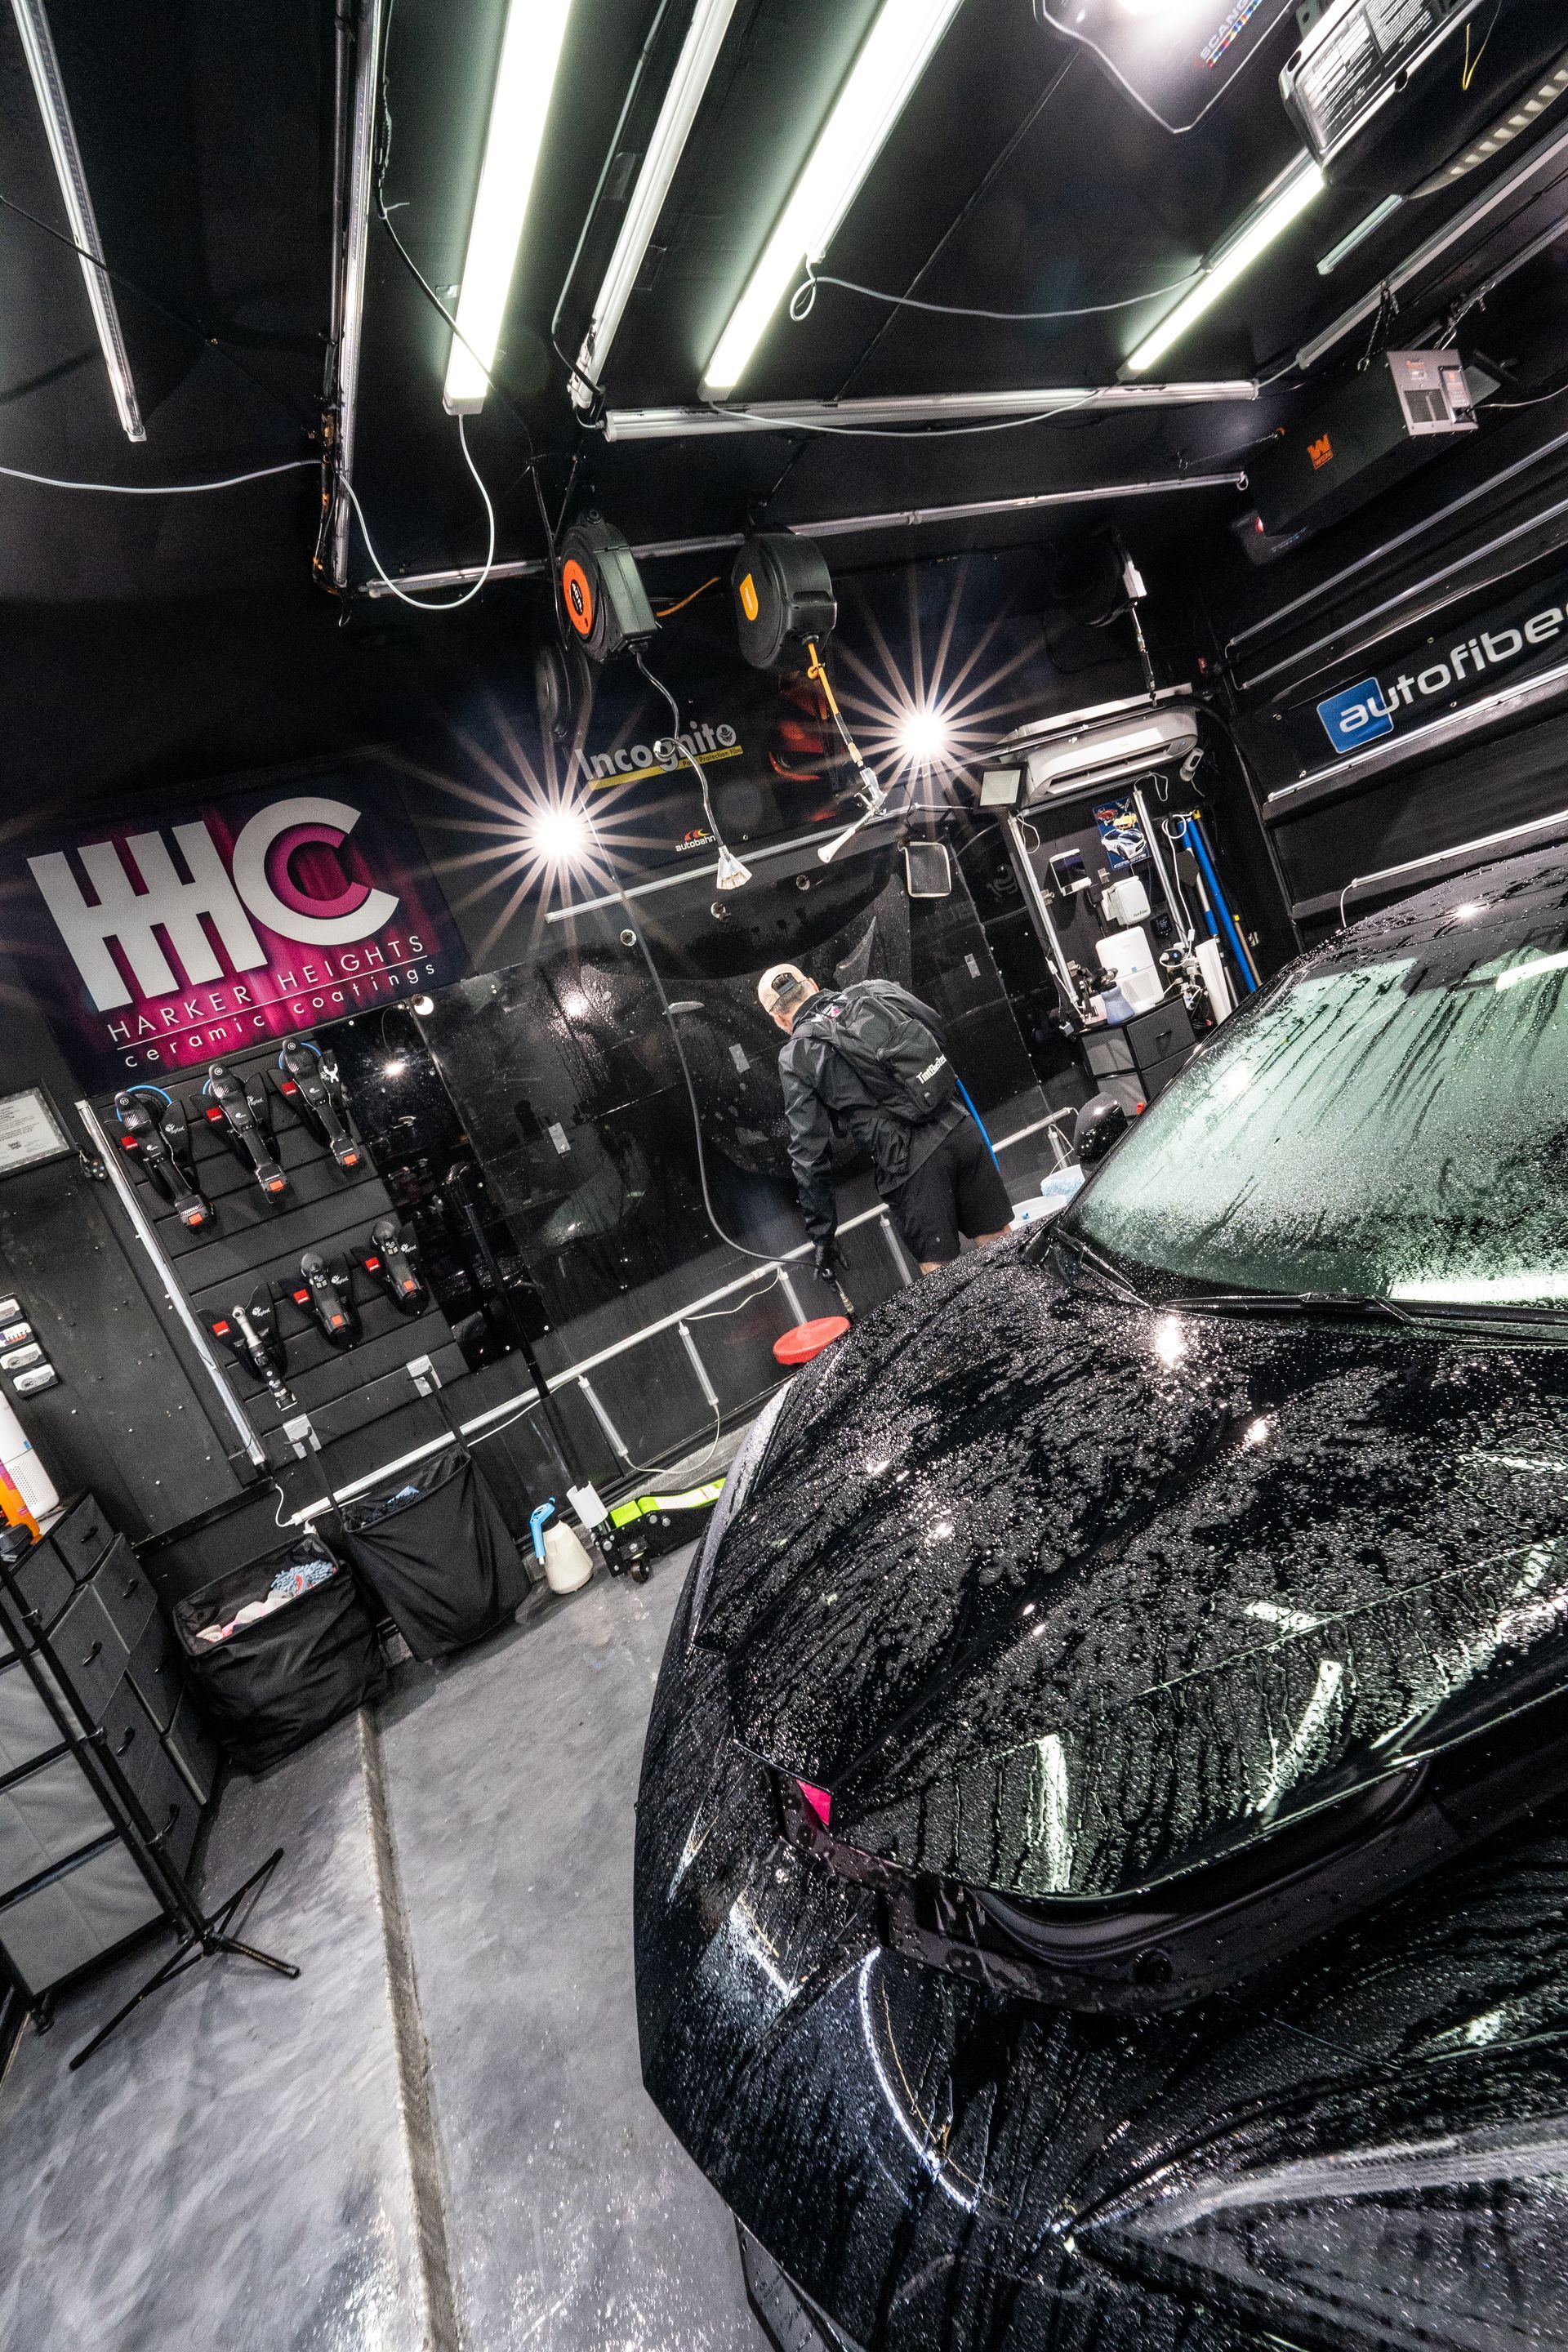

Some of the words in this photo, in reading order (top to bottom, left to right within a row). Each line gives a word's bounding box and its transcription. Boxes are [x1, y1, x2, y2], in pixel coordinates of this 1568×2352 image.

[1339, 603, 1568, 733] autofibe
[699, 751, 729, 763] Protection
[729, 748, 742, 756] Film
[675, 835, 716, 852] autobahn
[107, 986, 252, 1042] HARKER
[277, 936, 424, 991] HEIGHTS
[125, 1014, 265, 1067] ceramic
[293, 963, 434, 1014] coatings
